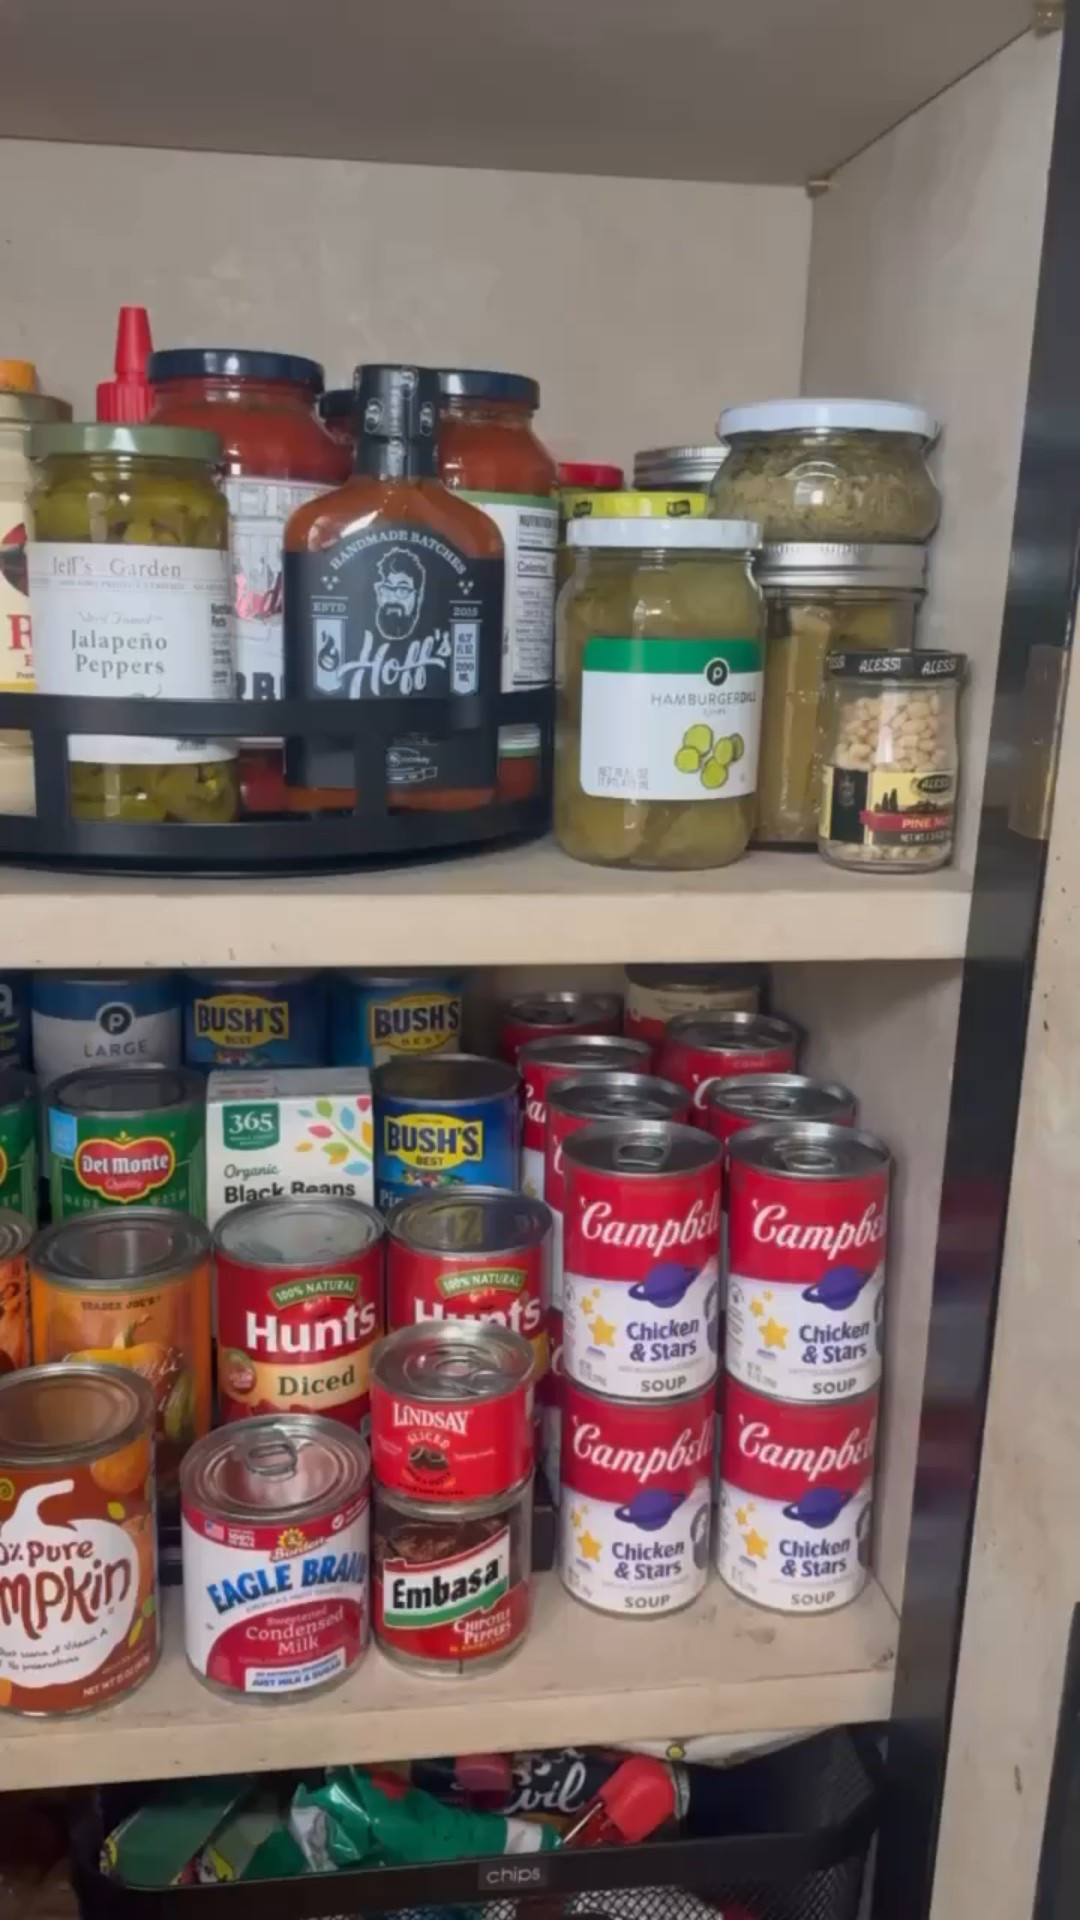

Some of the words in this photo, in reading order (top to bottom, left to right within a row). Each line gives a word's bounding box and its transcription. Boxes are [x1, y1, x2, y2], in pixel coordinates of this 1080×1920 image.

[330, 530, 408, 570] HANDMADE
[410, 532, 468, 575] BATCHES
[53, 555, 93, 577] Jeff's
[109, 557, 182, 578] Garden
[71, 630, 168, 654] Jalapeño
[75, 653, 165, 680] Peppers
[336, 629, 452, 699] Hoff's
[859, 657, 901, 674] ALESSI
[902, 818, 932, 829] PINE
[199, 1004, 285, 1034] BUSH'S
[374, 1001, 460, 1039] BUSH'S
[83, 1040, 147, 1058] LARGE
[228, 1110, 274, 1135] 365
[387, 1121, 479, 1157] BUSH'S
[82, 1154, 109, 1175] Del
[112, 1153, 169, 1175] Monte
[223, 1162, 280, 1181] Organic
[415, 1155, 444, 1167] BEST
[224, 1182, 285, 1204] Black
[275, 1286, 304, 1302] 100%
[305, 1280, 354, 1294] NATURAL
[471, 1273, 520, 1287] NATURAL
[626, 1319, 700, 1342] Chicken
[800, 1321, 871, 1343] Chicken
[629, 1343, 646, 1363] &
[650, 1340, 697, 1362] Stars
[802, 1346, 818, 1364] &
[822, 1344, 868, 1363] Stars
[277, 1365, 355, 1397] Diced
[641, 1375, 687, 1393] SOUP
[812, 1378, 857, 1395] SOUP
[393, 1402, 469, 1435] LINDSAY
[407, 1431, 450, 1450] SLICED
[611, 1541, 685, 1561] Chicken
[779, 1538, 851, 1558] Chicken
[614, 1562, 630, 1580] &
[634, 1560, 682, 1581] Stars
[780, 1559, 796, 1577] &
[800, 1558, 847, 1577] Stars
[206, 1564, 293, 1611] EAGLE
[392, 1559, 499, 1609] Embasa
[623, 1594, 671, 1609] SOUP
[790, 1591, 836, 1606] SOUP
[245, 1605, 344, 1641] Condensed
[266, 1605, 328, 1626] Sweetened
[277, 1635, 319, 1656] Milk
[486, 1865, 541, 1885] chips
